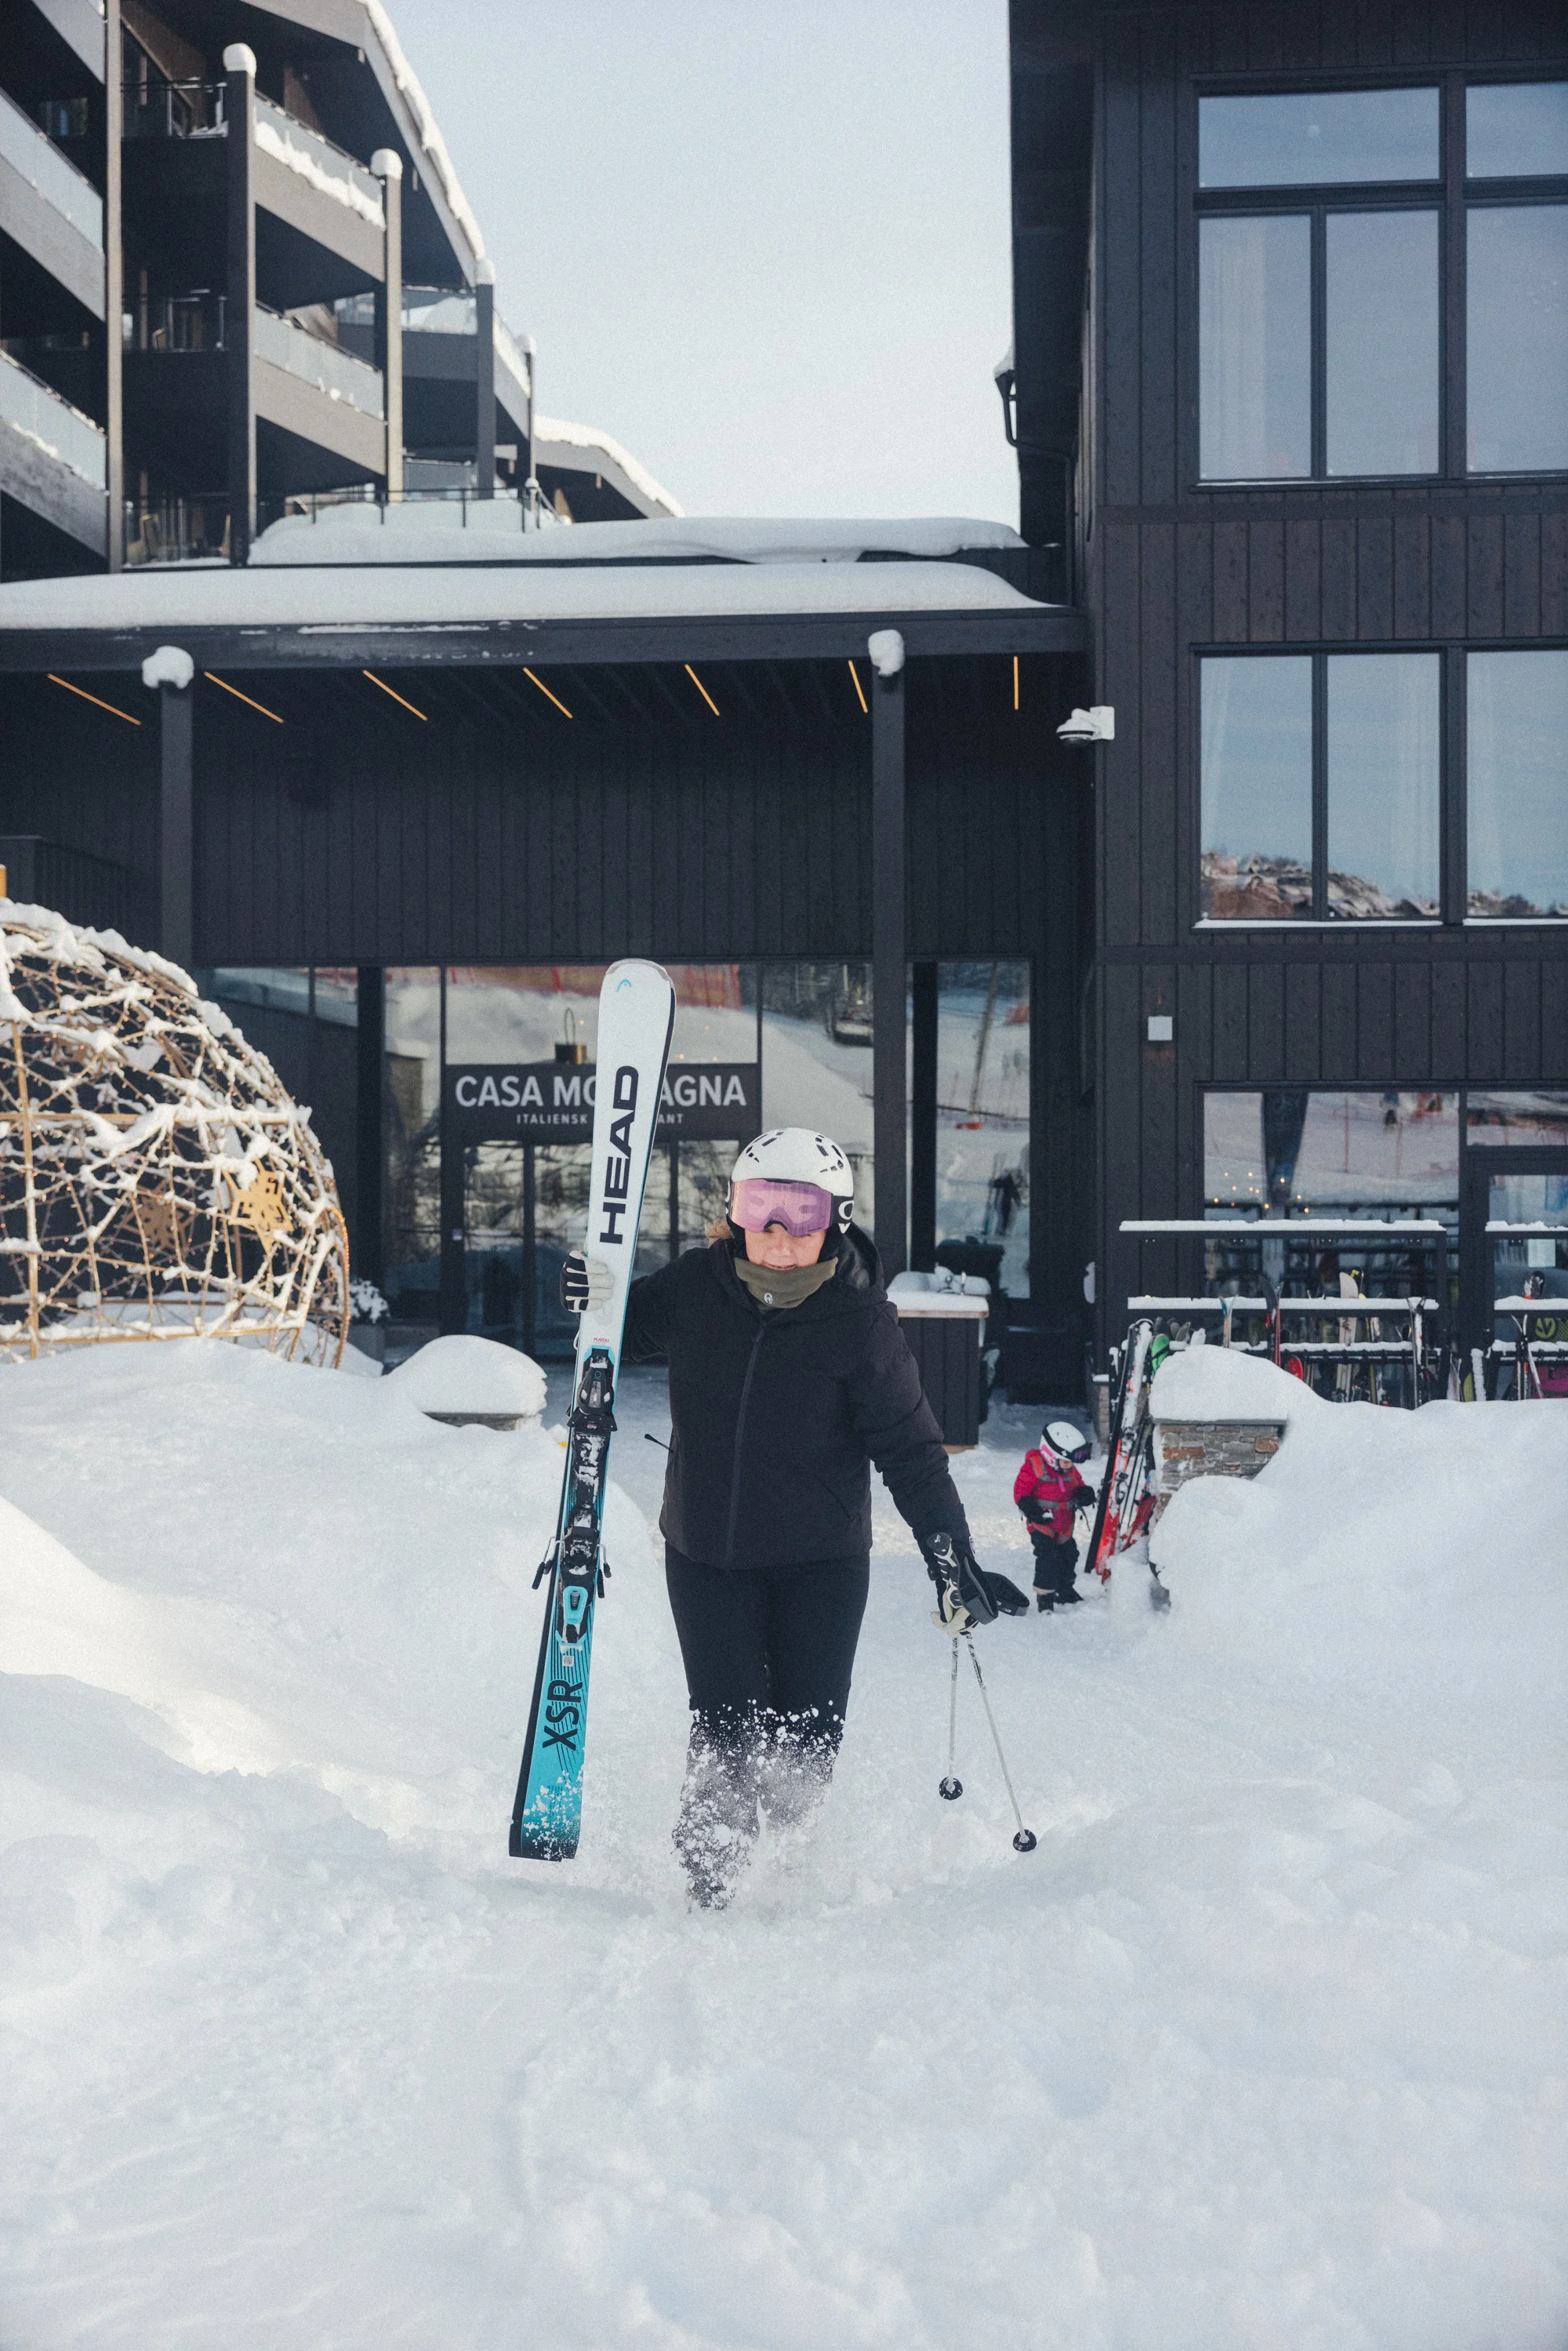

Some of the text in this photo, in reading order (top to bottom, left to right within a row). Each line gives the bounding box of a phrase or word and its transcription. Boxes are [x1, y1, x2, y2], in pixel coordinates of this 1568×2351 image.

[456, 1075, 746, 1107] CASA MOAGNA
[516, 1113, 588, 1125] ITALIENSK
[600, 1065, 639, 1244] HEAD
[542, 1679, 583, 1752] XSR
